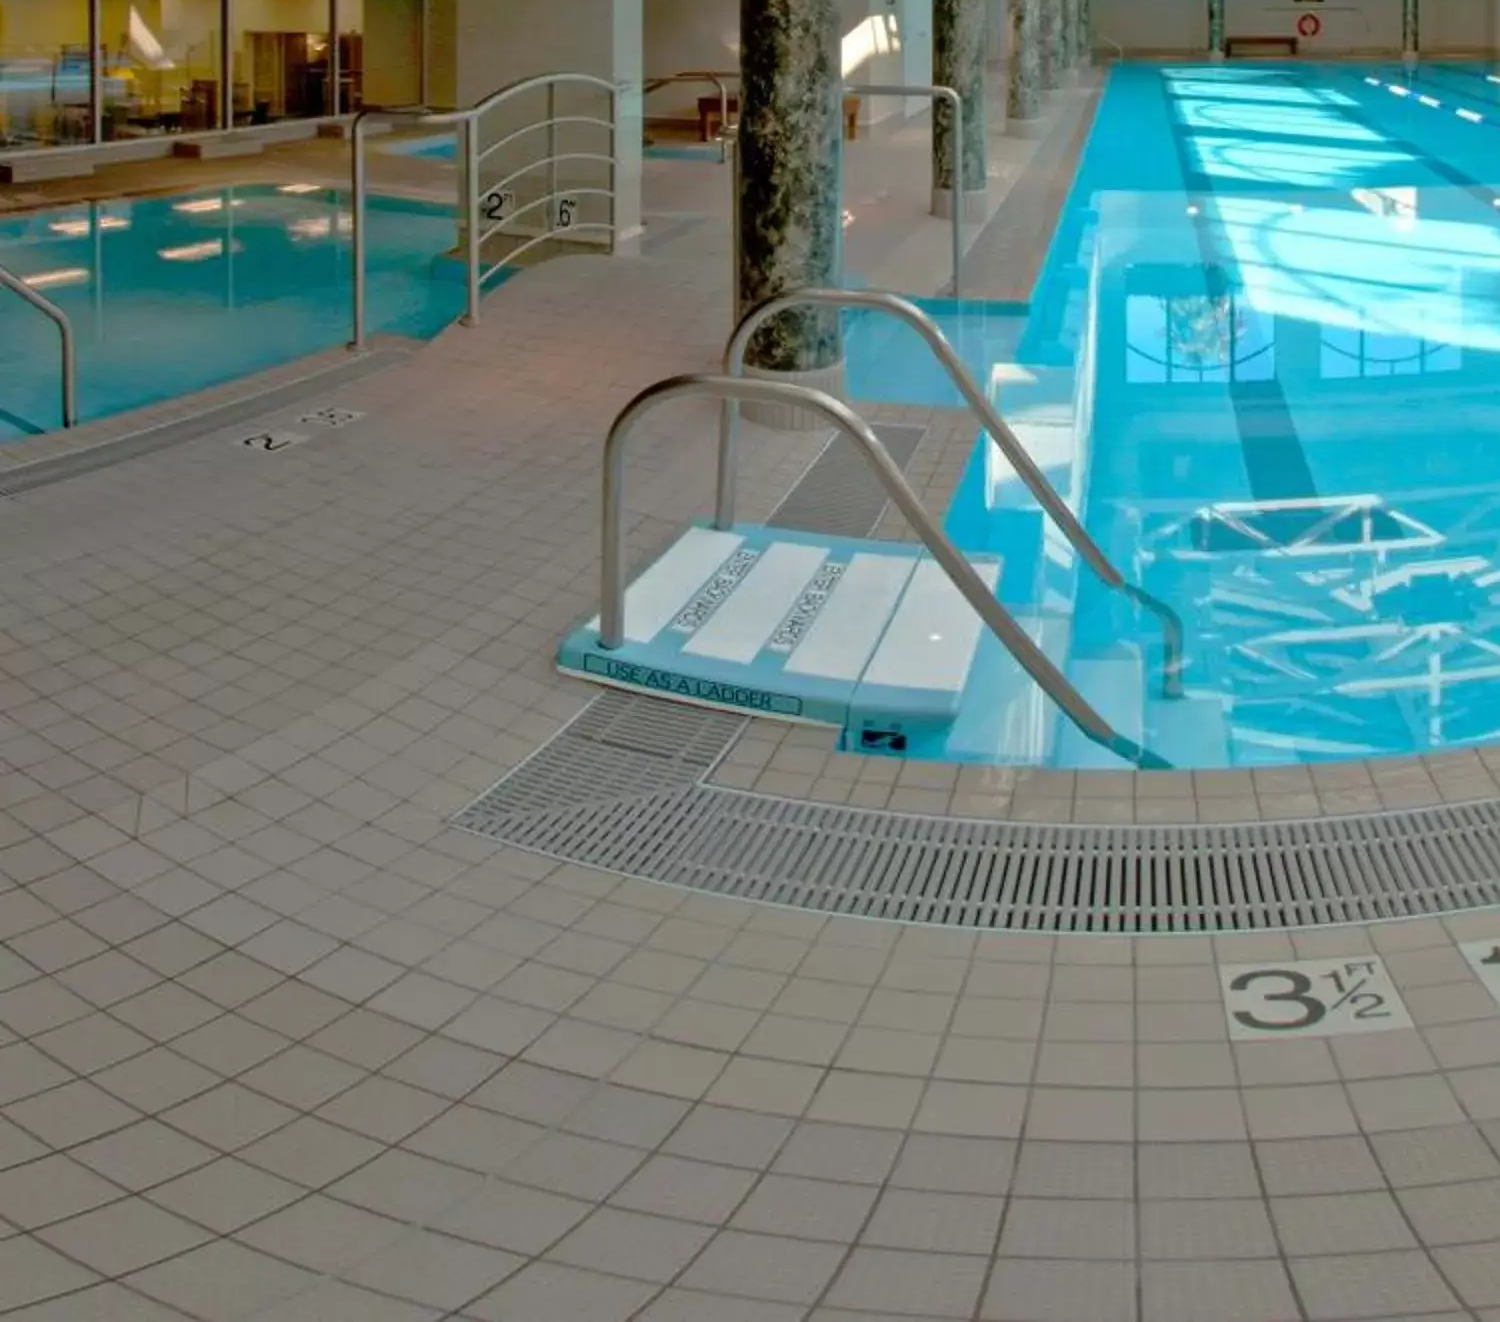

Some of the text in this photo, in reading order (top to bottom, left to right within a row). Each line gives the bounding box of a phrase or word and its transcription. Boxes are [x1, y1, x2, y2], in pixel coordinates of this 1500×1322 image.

[606, 661, 772, 709] USE AS A LADDER
